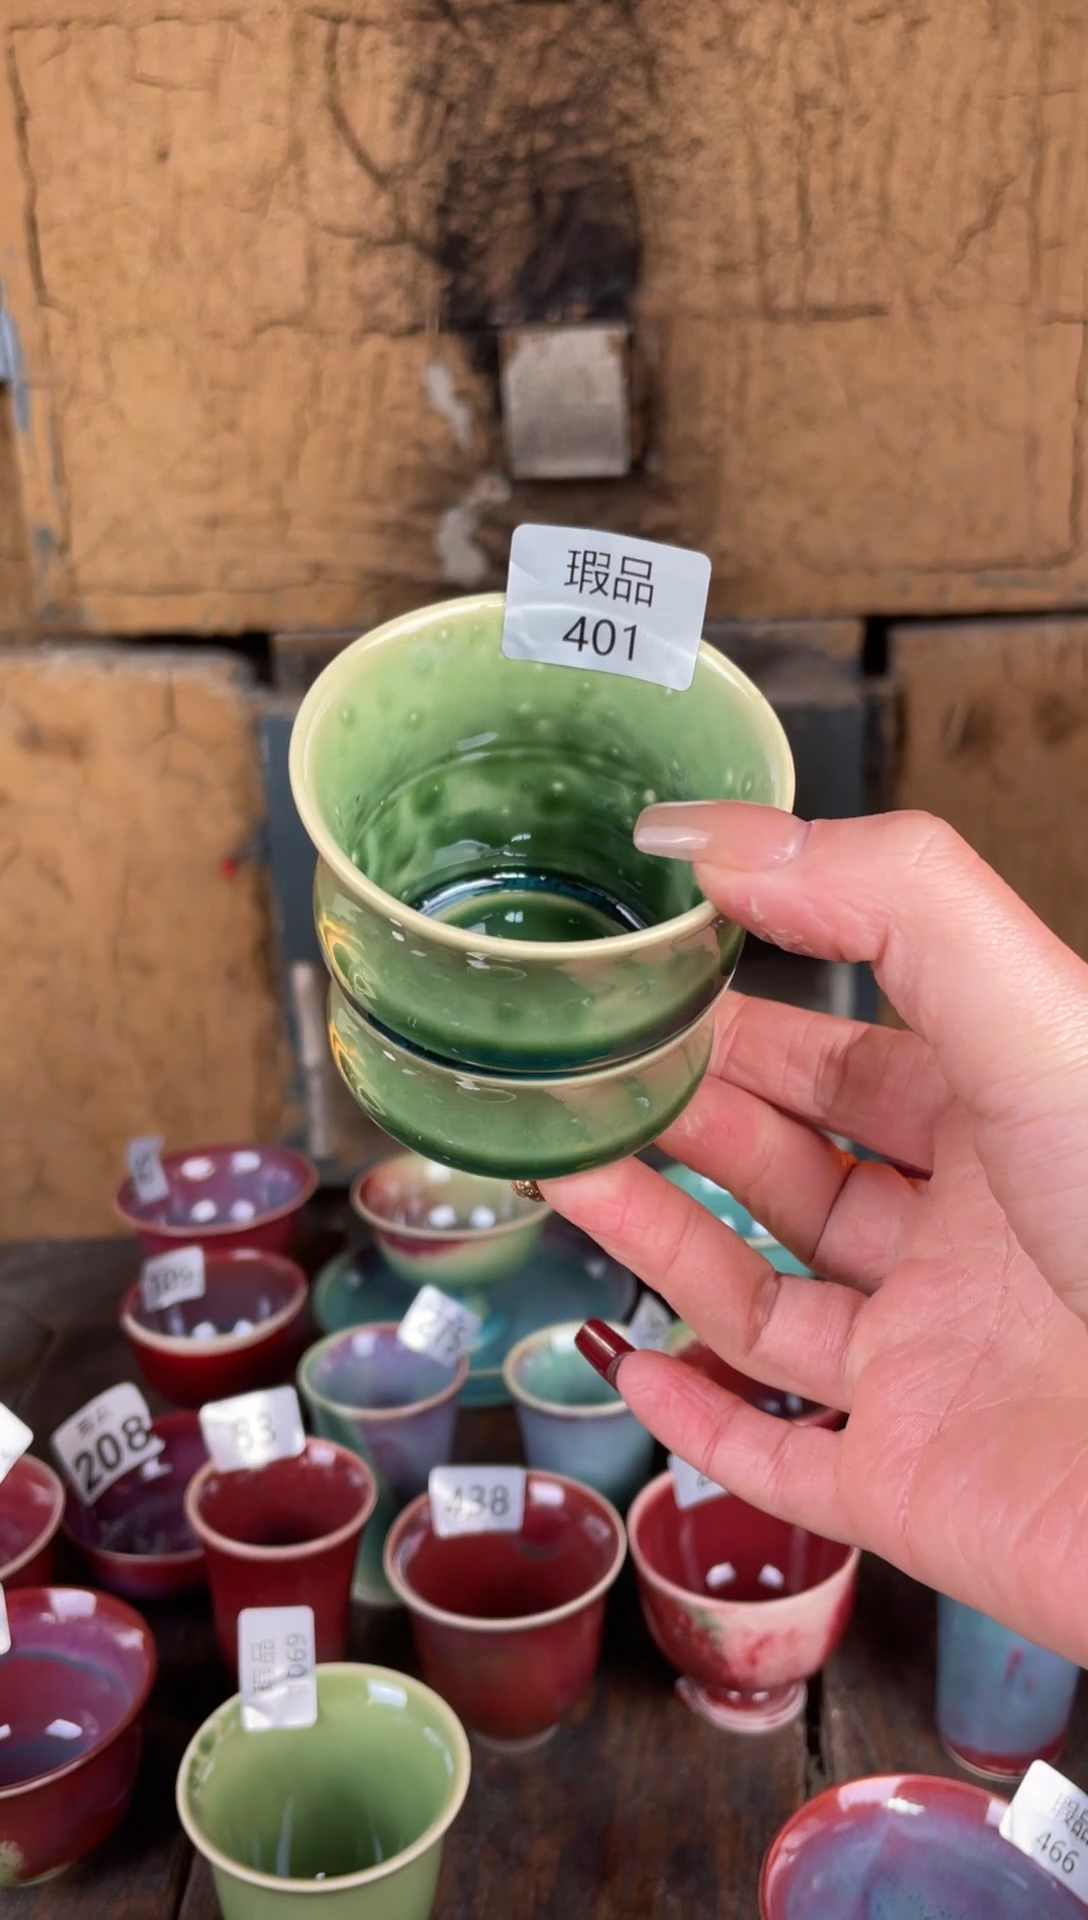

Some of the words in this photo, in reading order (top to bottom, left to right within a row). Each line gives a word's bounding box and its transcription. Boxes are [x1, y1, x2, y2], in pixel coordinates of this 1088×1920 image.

[563, 549, 655, 608] 瑕品
[562, 616, 638, 661] 401
[75, 1416, 150, 1493] 208
[1036, 1832, 1080, 1875] 466
